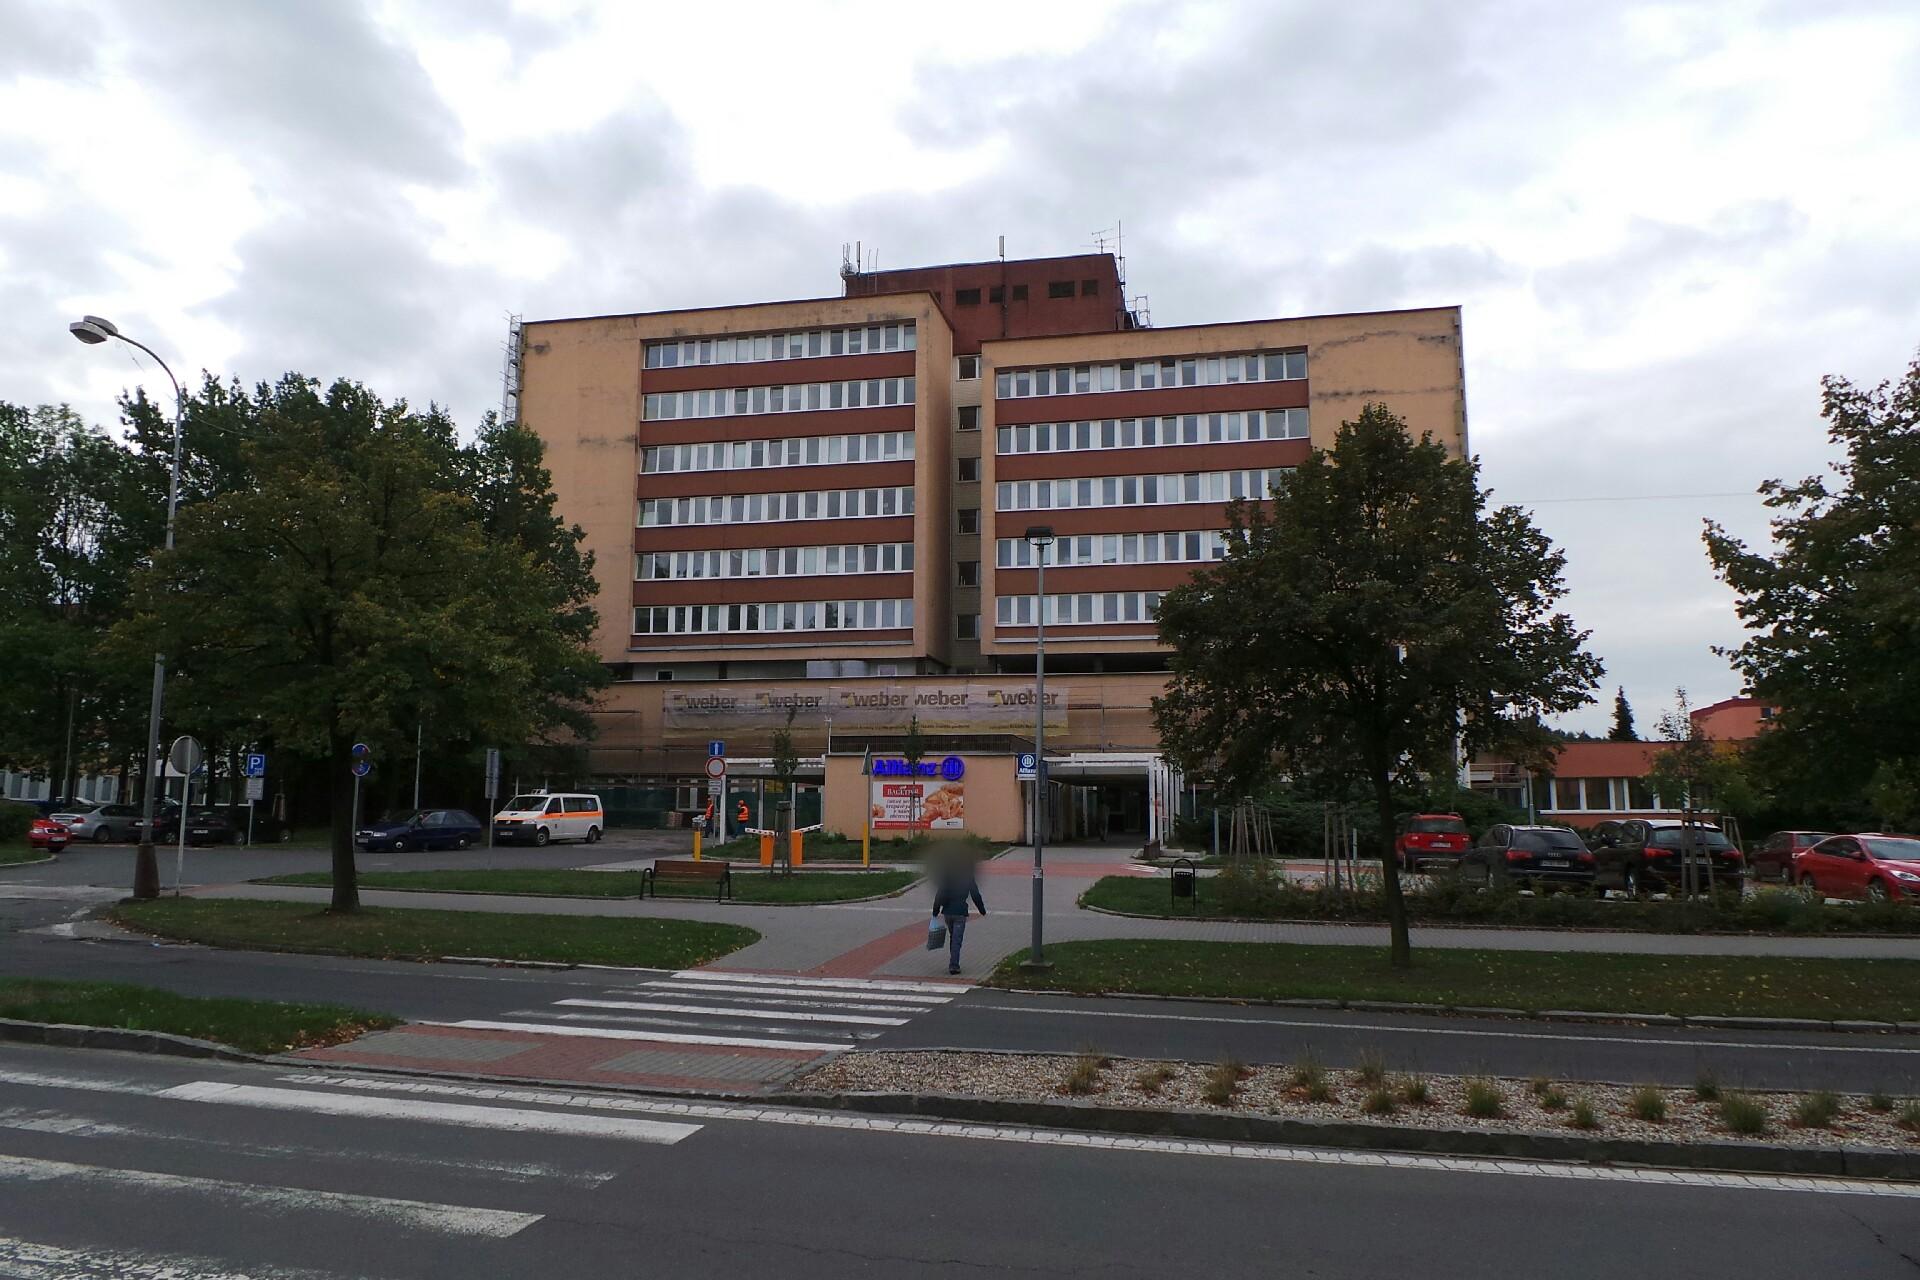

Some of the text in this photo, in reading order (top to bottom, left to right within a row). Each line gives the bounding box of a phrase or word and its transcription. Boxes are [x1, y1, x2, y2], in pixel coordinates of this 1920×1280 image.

[687, 693, 738, 709] weber
[768, 692, 823, 708] weber
[852, 691, 908, 707] weber
[914, 689, 968, 705] weber
[1001, 688, 1059, 705] weber
[250, 756, 261, 770] P
